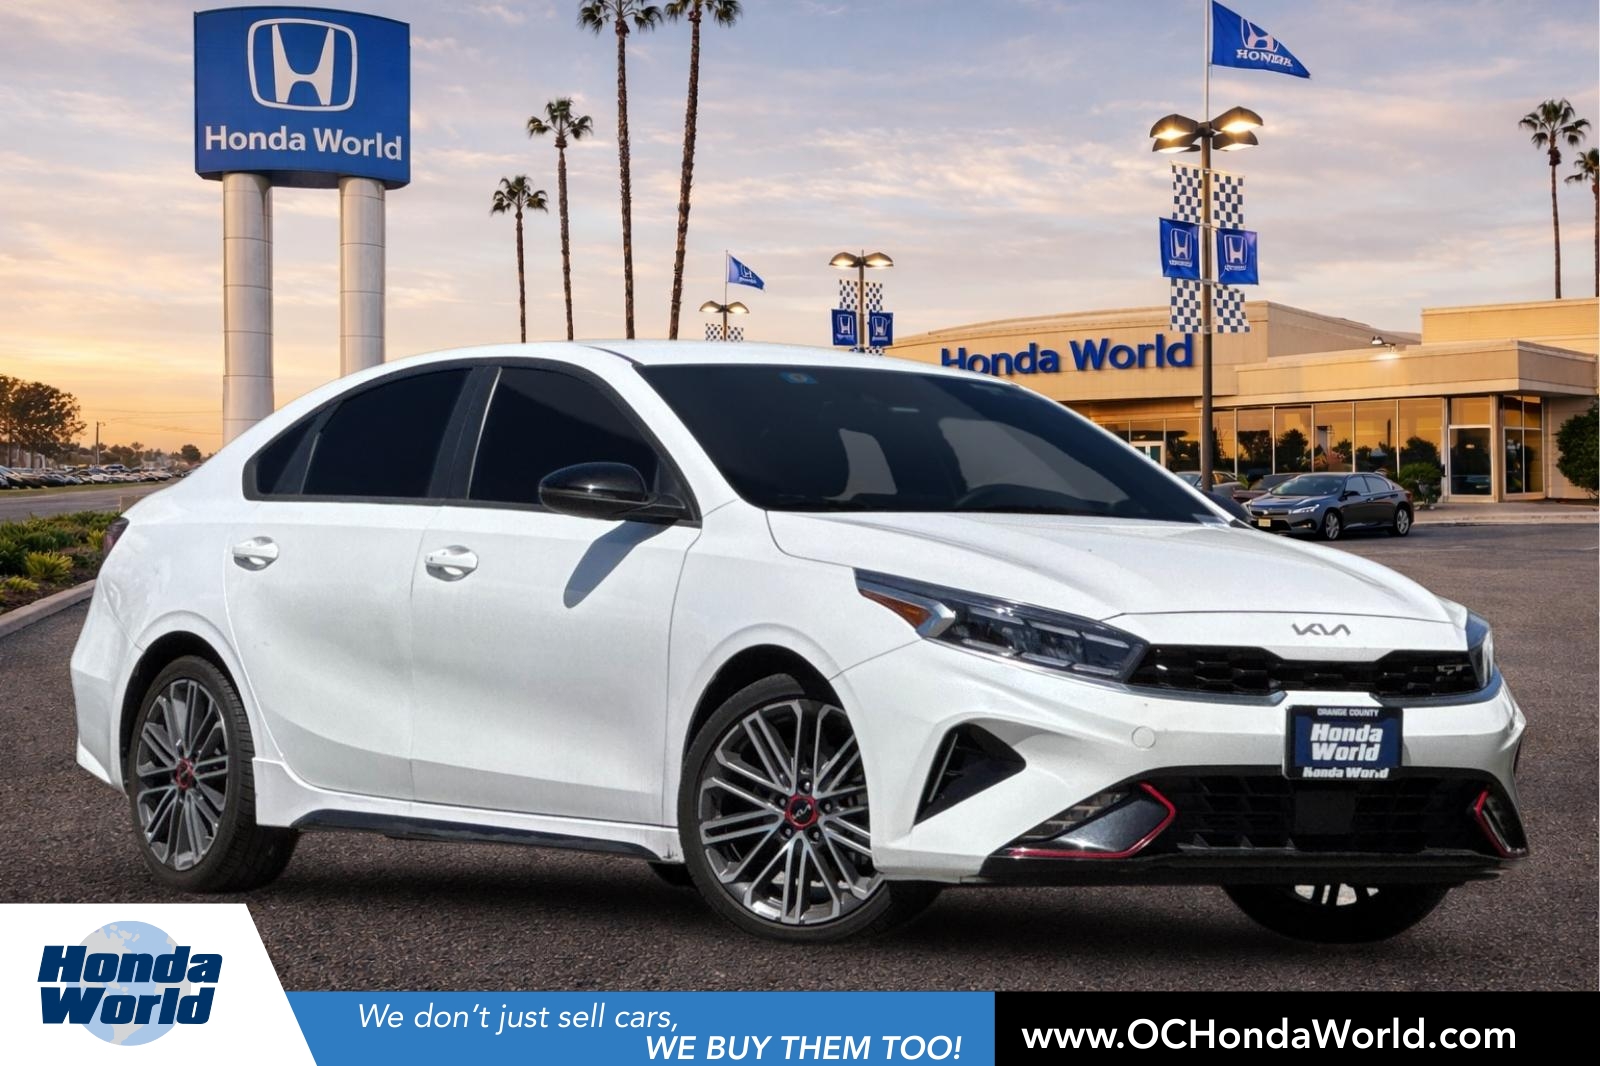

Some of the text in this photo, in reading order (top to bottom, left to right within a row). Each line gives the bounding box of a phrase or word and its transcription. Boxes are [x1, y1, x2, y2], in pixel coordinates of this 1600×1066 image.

[205, 125, 402, 160] Honda World
[941, 333, 1195, 376] Honda World
[1317, 708, 1379, 717] ORANGE COUNTY
[1310, 723, 1384, 742] Honda
[1312, 742, 1381, 761] World
